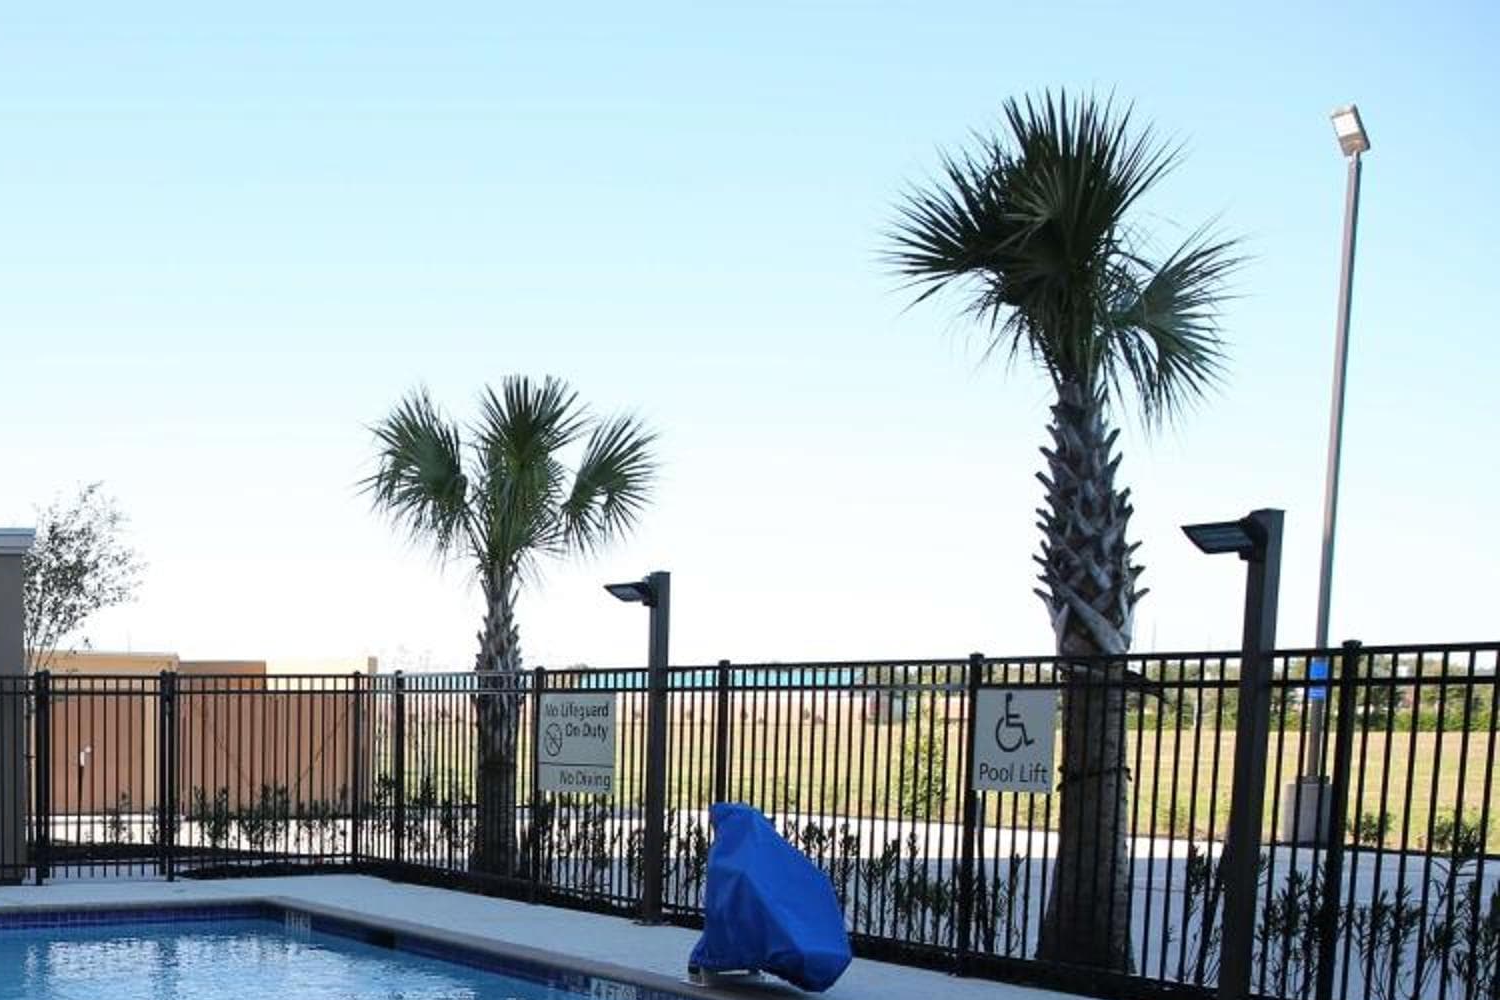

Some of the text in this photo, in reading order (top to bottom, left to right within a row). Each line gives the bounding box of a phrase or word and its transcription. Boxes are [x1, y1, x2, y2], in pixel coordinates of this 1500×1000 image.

[545, 701, 609, 721] No Lifeguard
[565, 722, 609, 742] On Duty
[559, 770, 612, 791] No Diving
[979, 762, 1049, 784] Pool Lift
